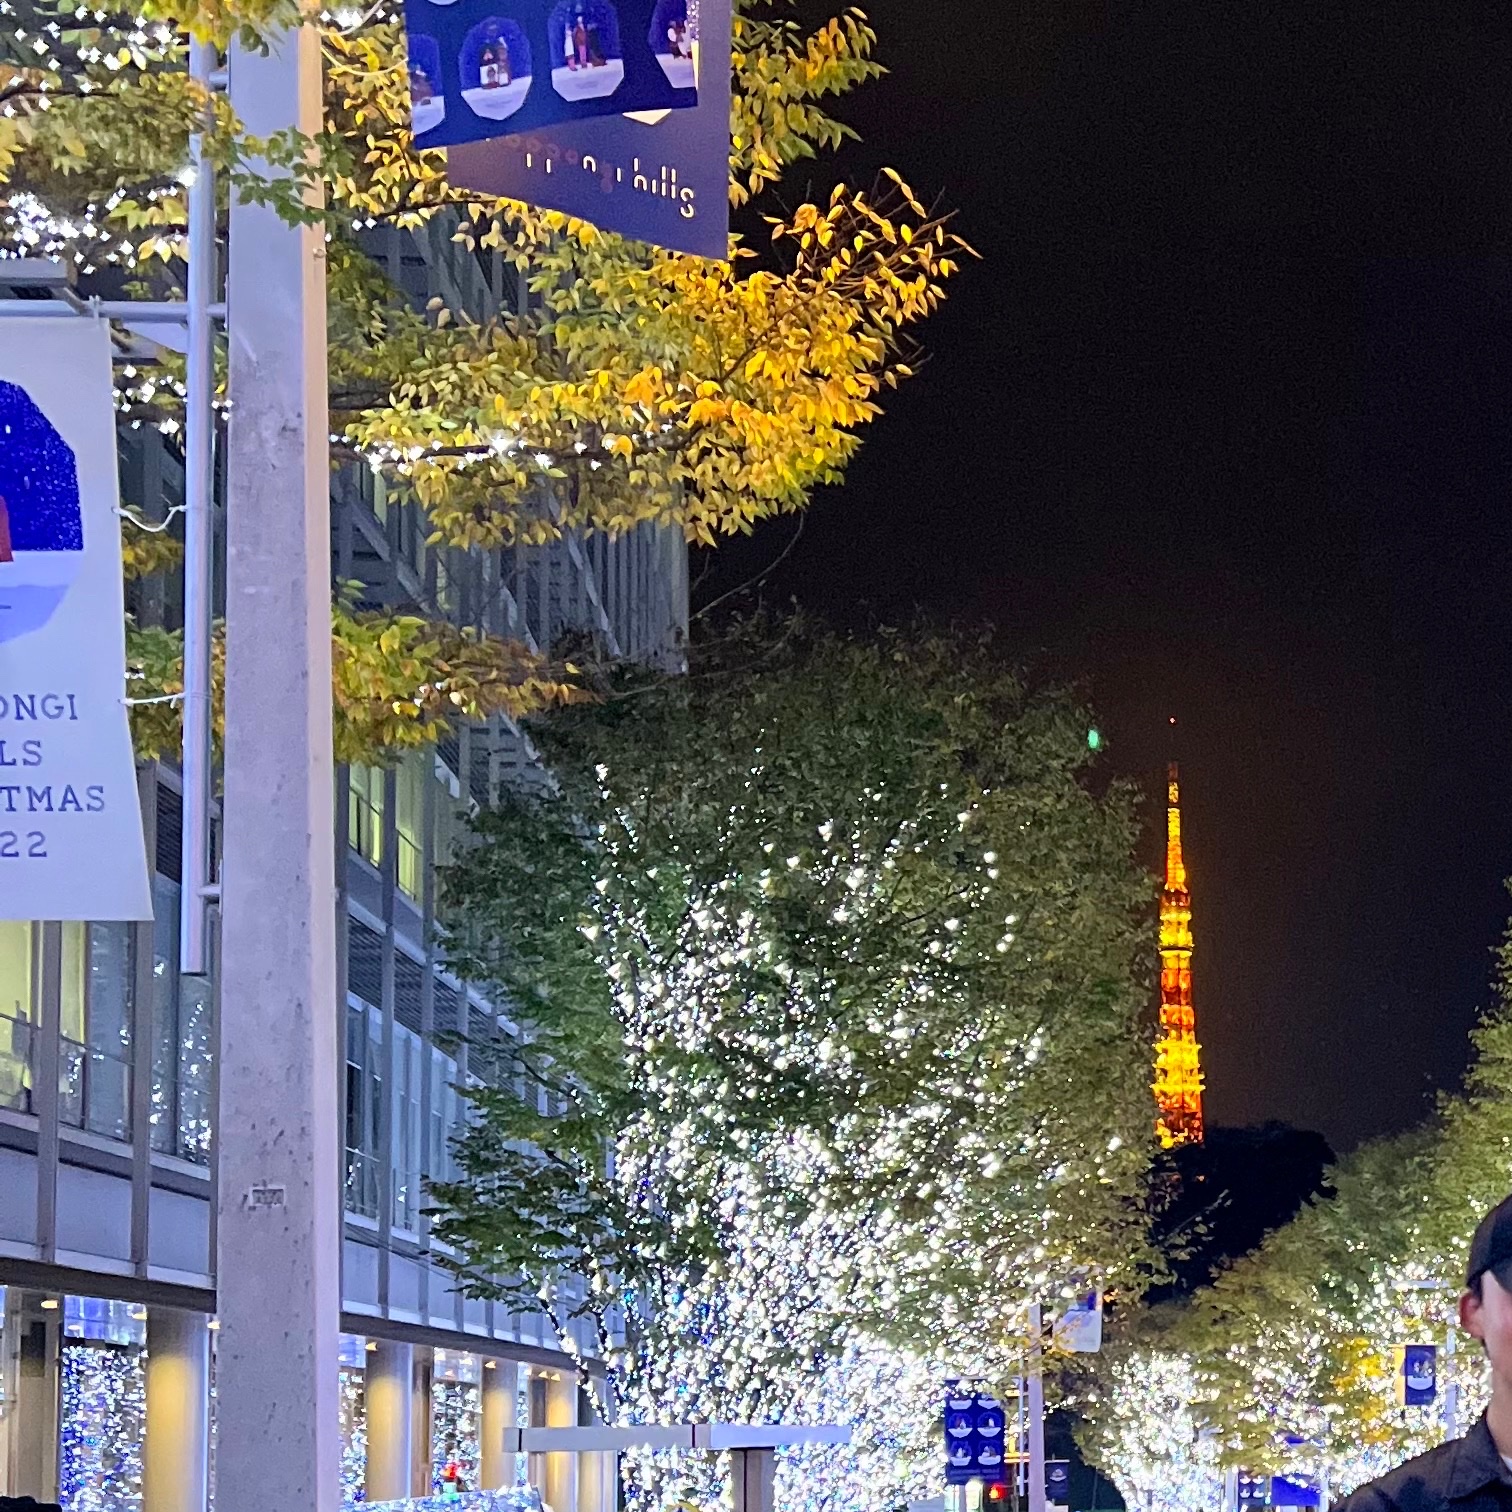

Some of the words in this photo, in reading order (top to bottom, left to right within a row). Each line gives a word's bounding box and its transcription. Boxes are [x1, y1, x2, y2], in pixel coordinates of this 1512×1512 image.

[633, 157, 694, 218] hills
[0, 740, 43, 767] LS
[0, 785, 105, 812] TMAS
[0, 830, 48, 858] 22
